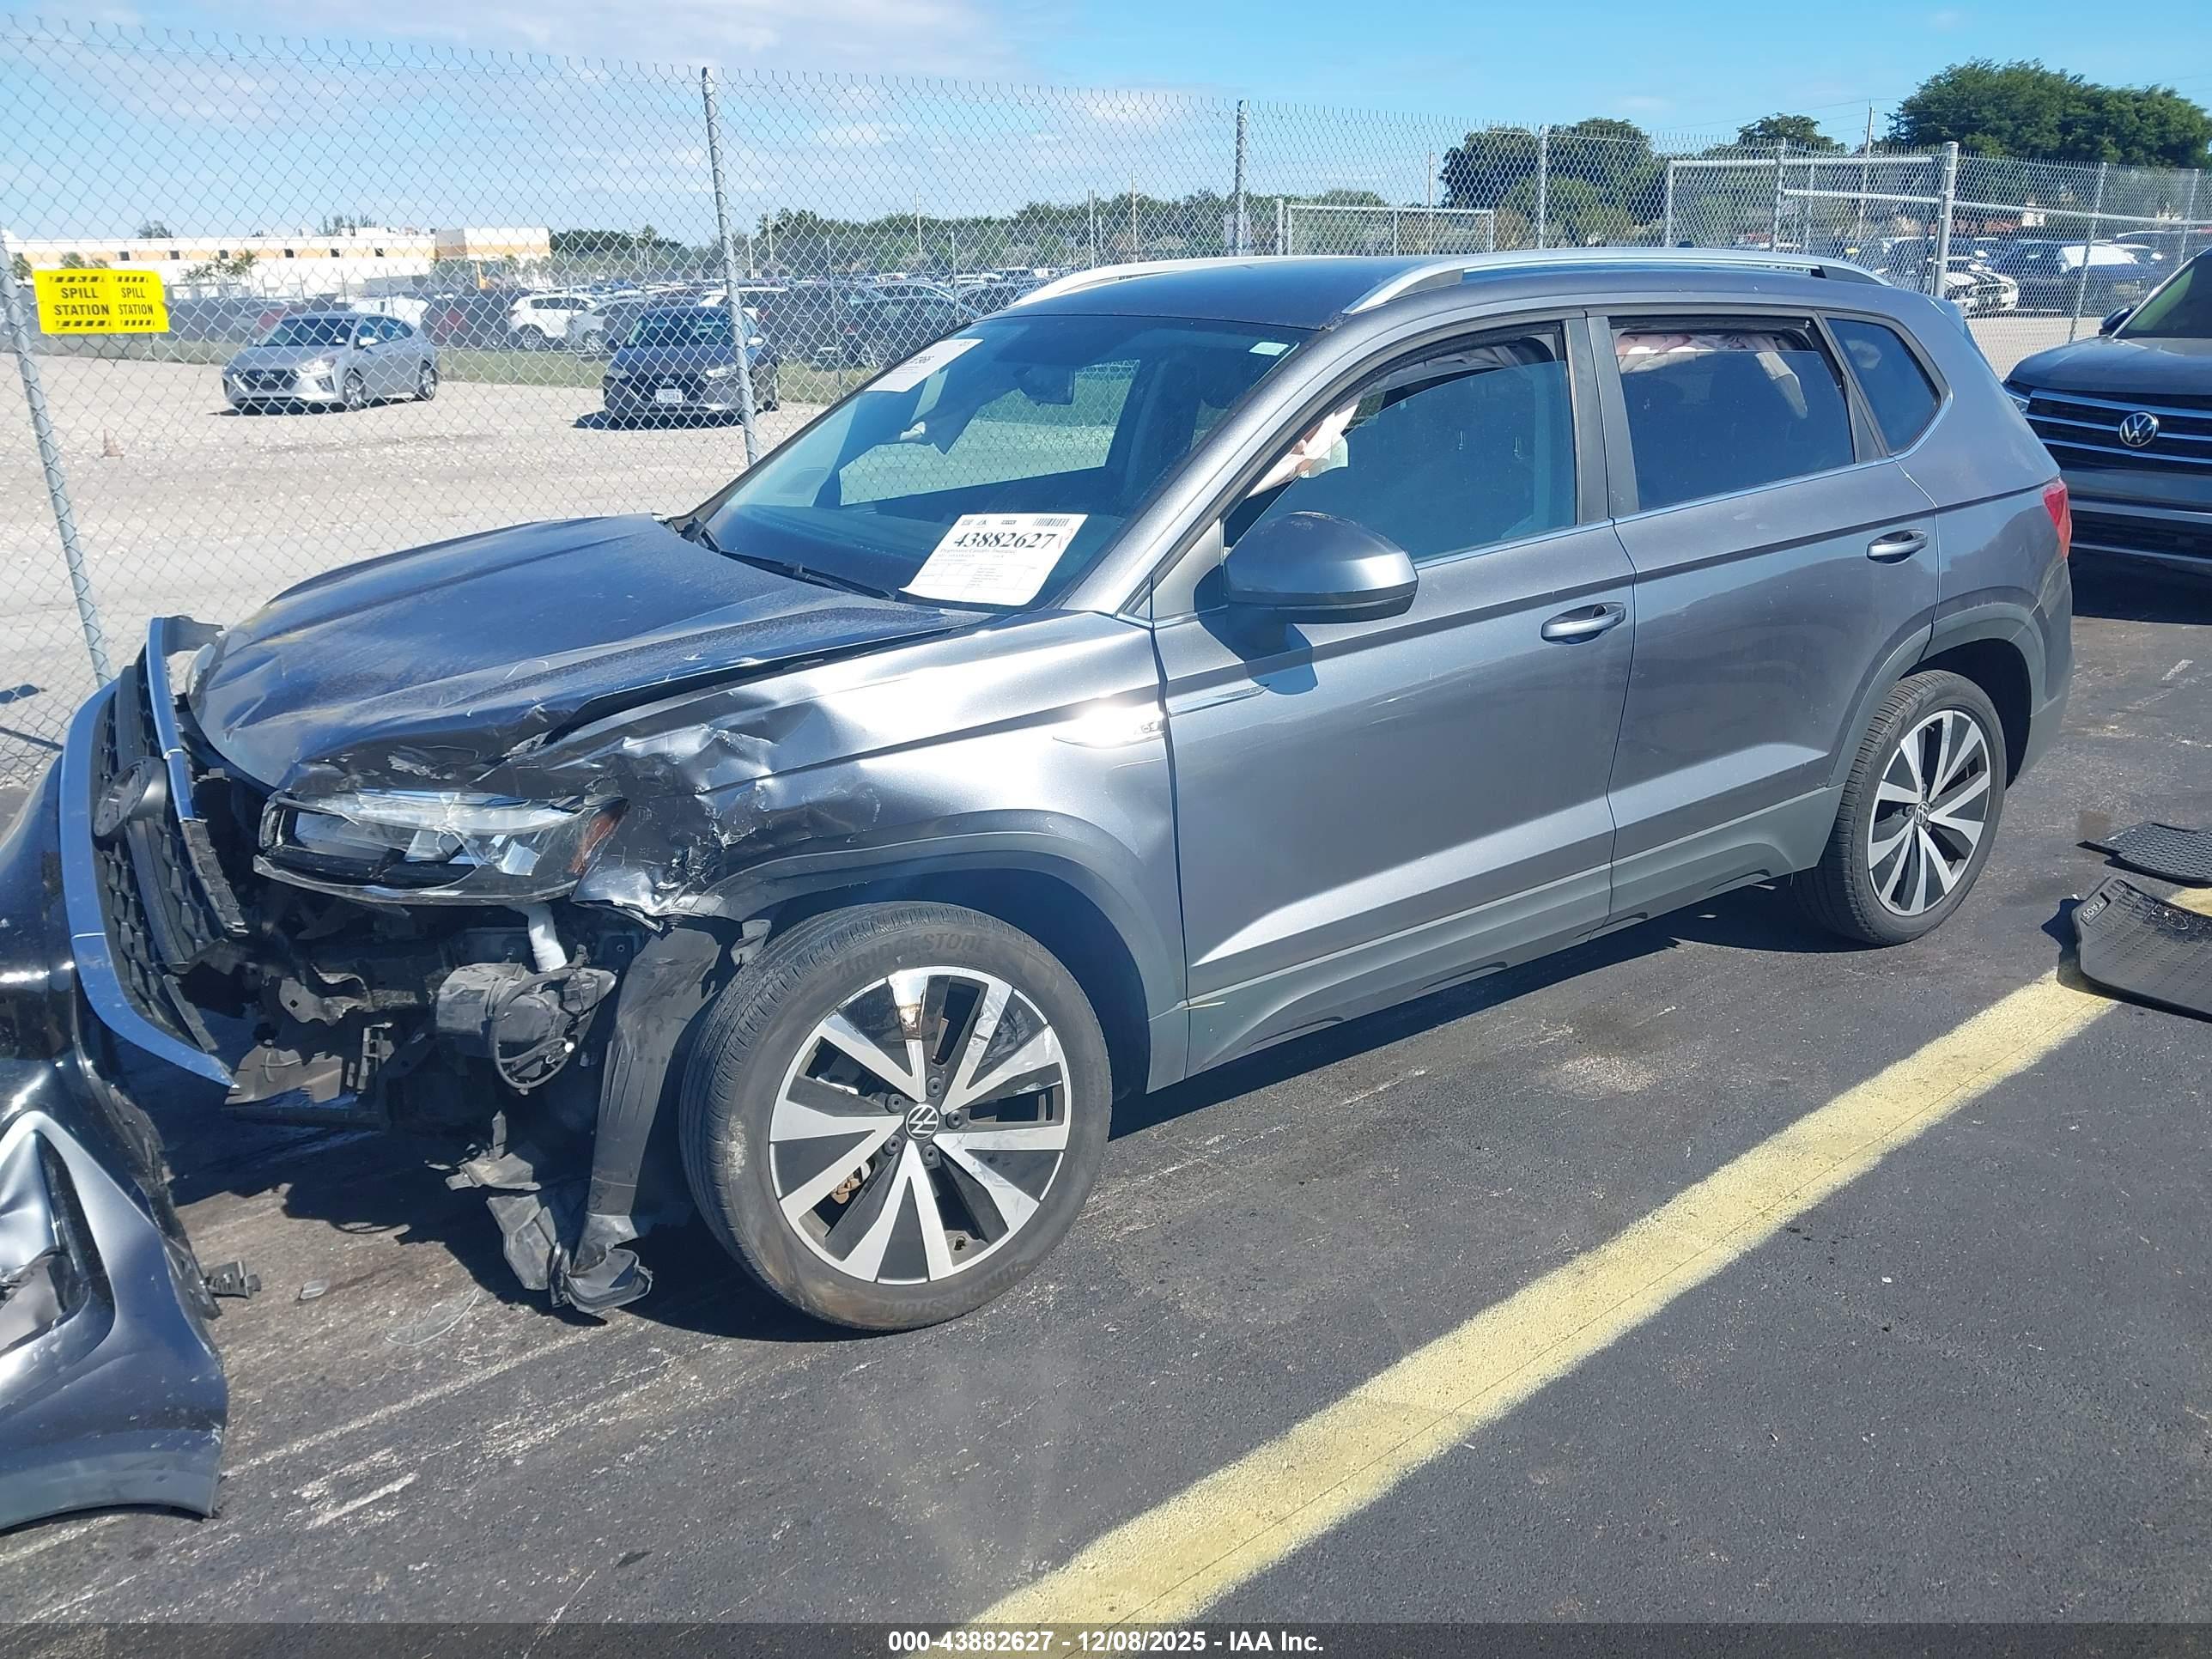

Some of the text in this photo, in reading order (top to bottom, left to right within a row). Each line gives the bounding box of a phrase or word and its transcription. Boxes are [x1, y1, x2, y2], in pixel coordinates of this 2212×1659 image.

[61, 288, 99, 299] SPILL
[121, 287, 146, 298] SPILL
[54, 304, 110, 315] STATION
[118, 304, 154, 315] STATION
[954, 532, 1057, 549] 43882627
[2082, 902, 2104, 919] TAOS
